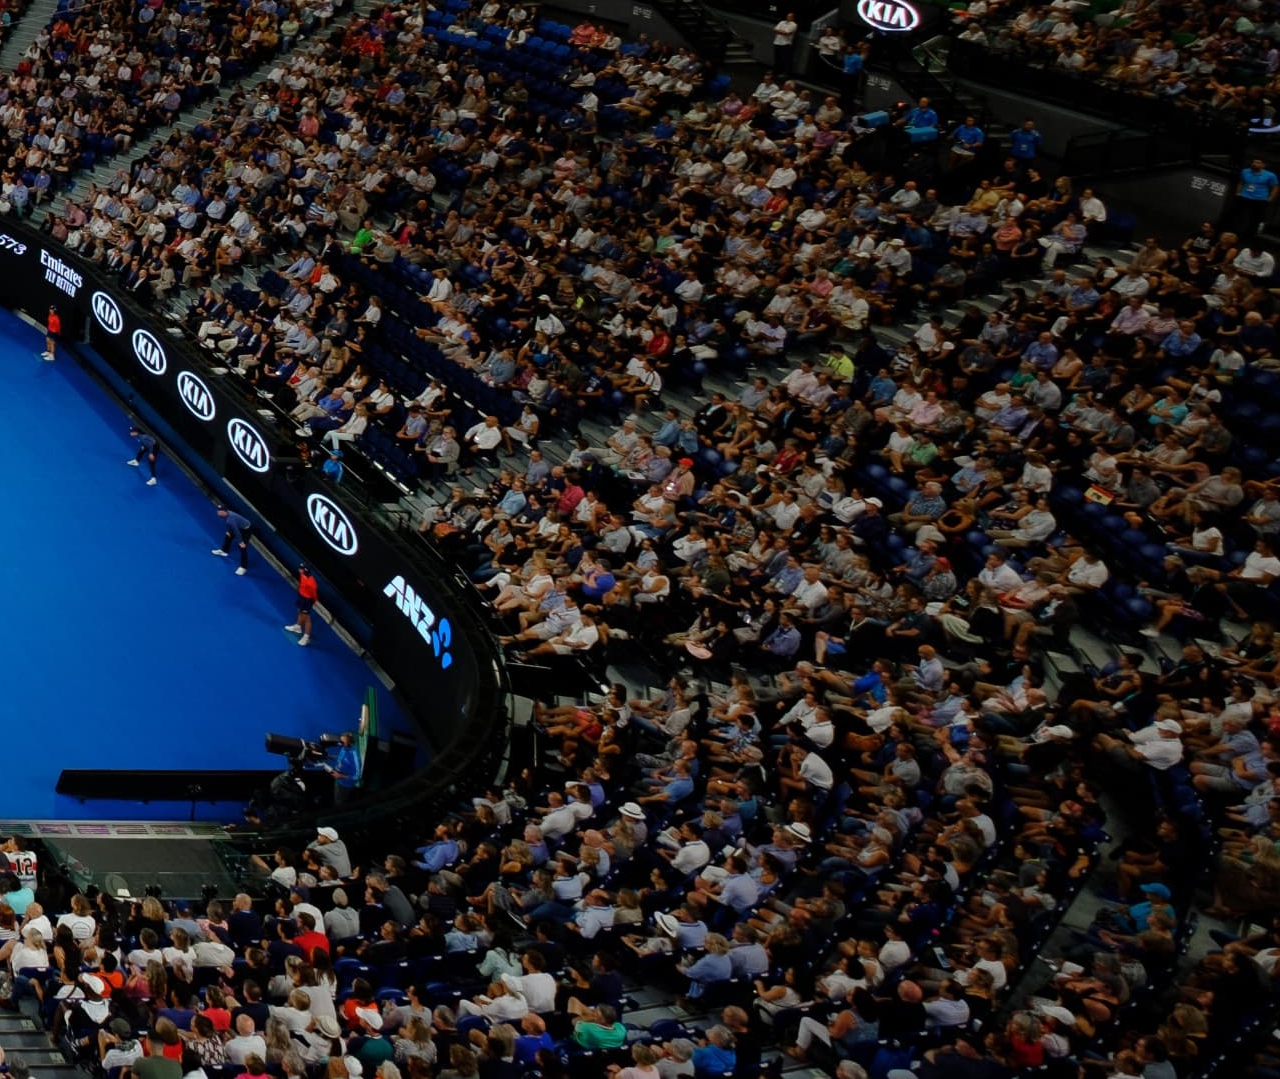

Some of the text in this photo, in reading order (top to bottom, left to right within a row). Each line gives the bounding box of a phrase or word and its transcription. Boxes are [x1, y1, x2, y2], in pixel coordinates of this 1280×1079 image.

[868, 1, 906, 26] KIA
[41, 249, 83, 288] Emirates
[45, 268, 76, 298] FLY BETTER
[97, 296, 117, 328] KIA
[138, 334, 160, 369] KIA
[183, 376, 208, 415] KIA
[235, 424, 262, 466] KIA
[315, 500, 348, 548] KIA
[383, 575, 435, 644] ANZ
[15, 858, 33, 876] 12
